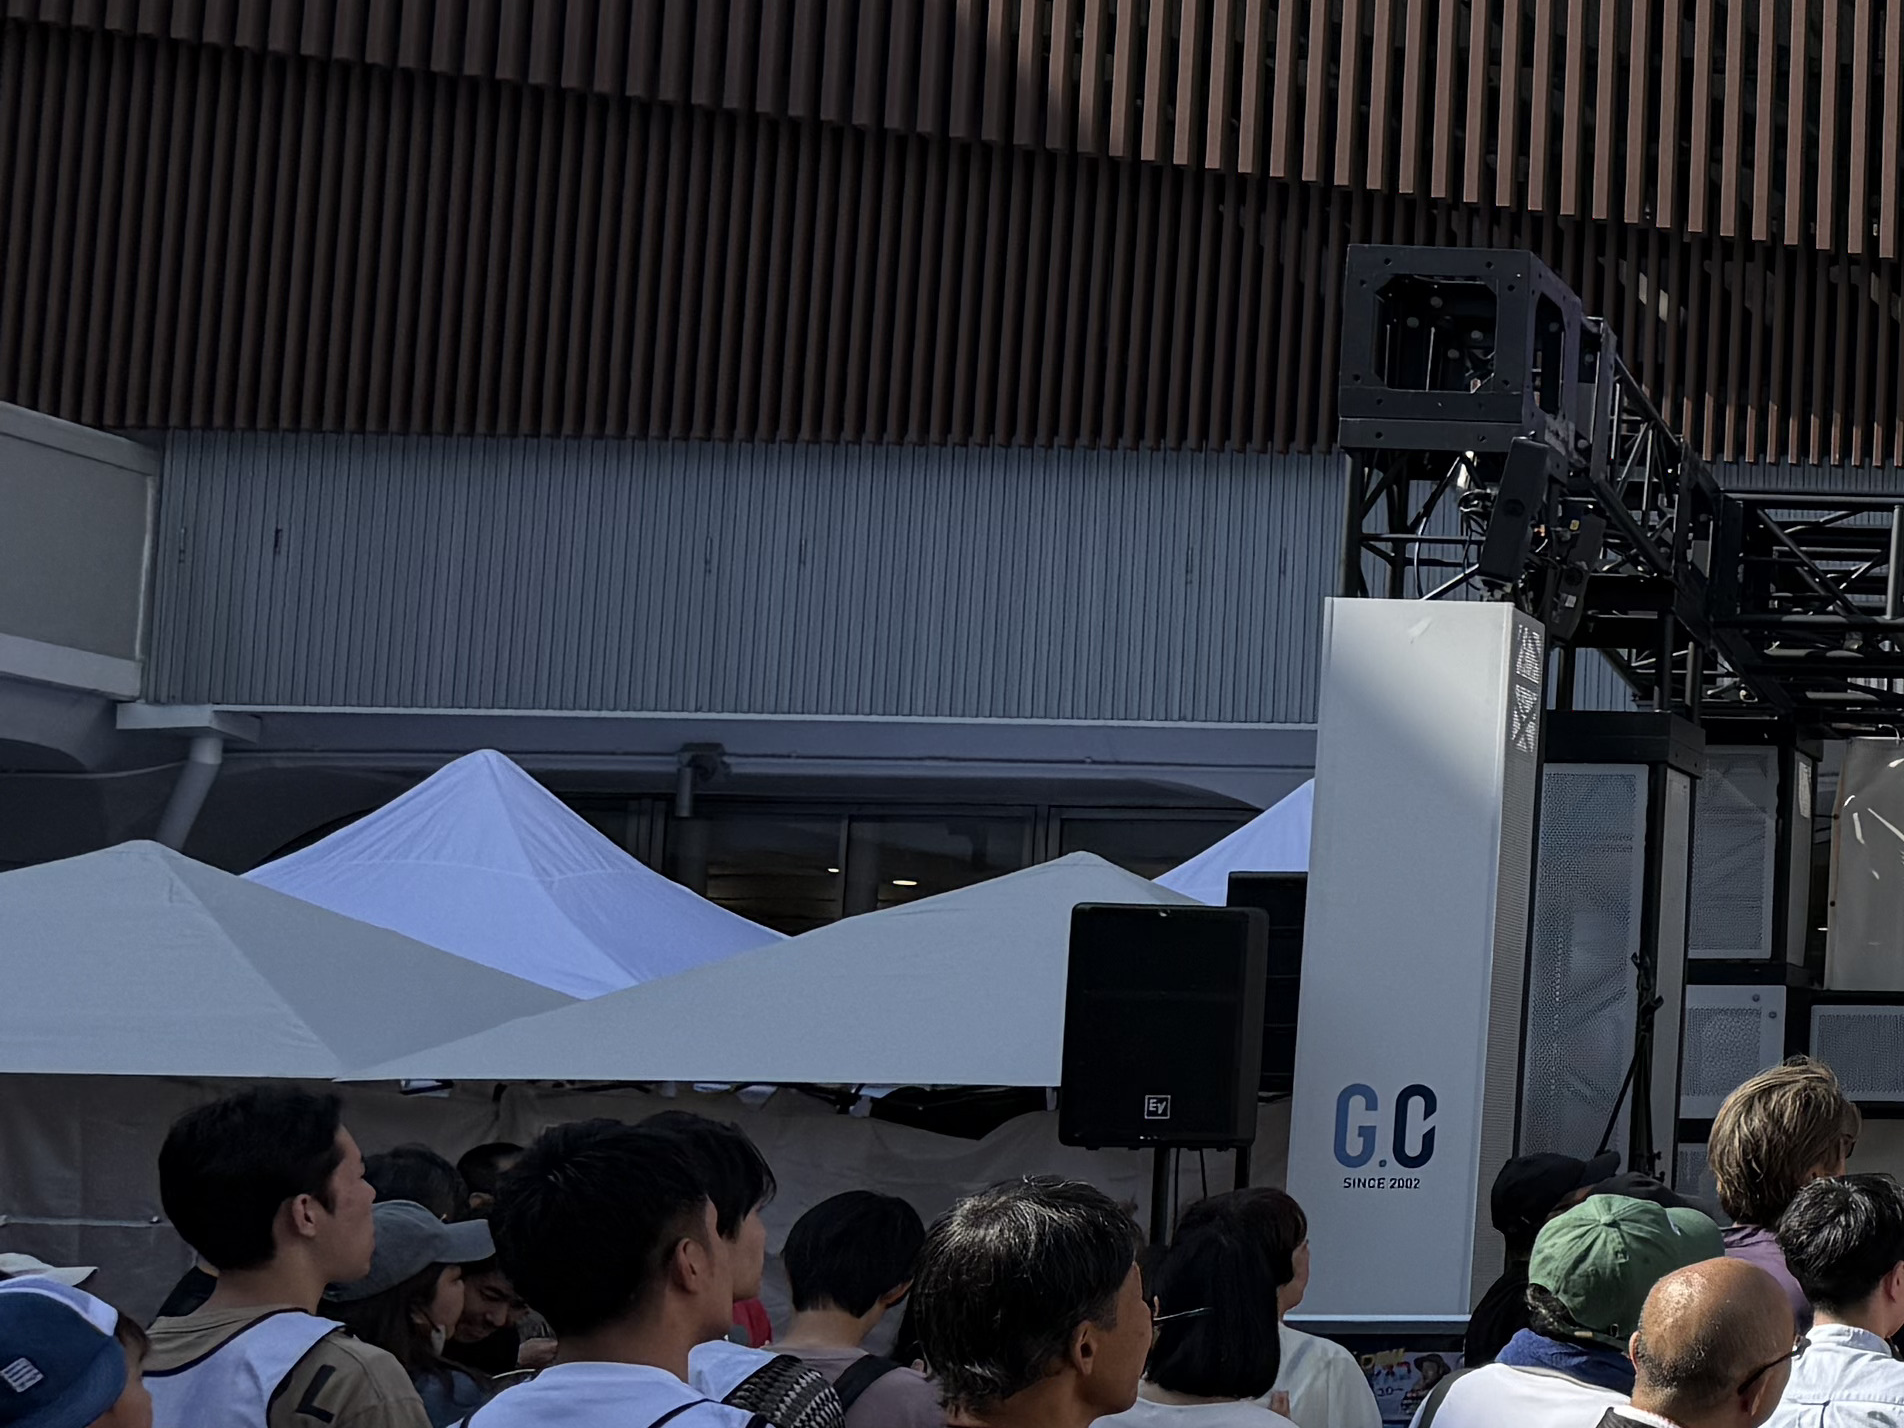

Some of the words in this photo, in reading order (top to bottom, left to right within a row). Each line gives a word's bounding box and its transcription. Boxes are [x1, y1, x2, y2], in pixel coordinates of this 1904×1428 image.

[1333, 1082, 1438, 1169] G.C
[1343, 1176, 1386, 1190] SINCE
[1388, 1177, 1421, 1190] 2002
